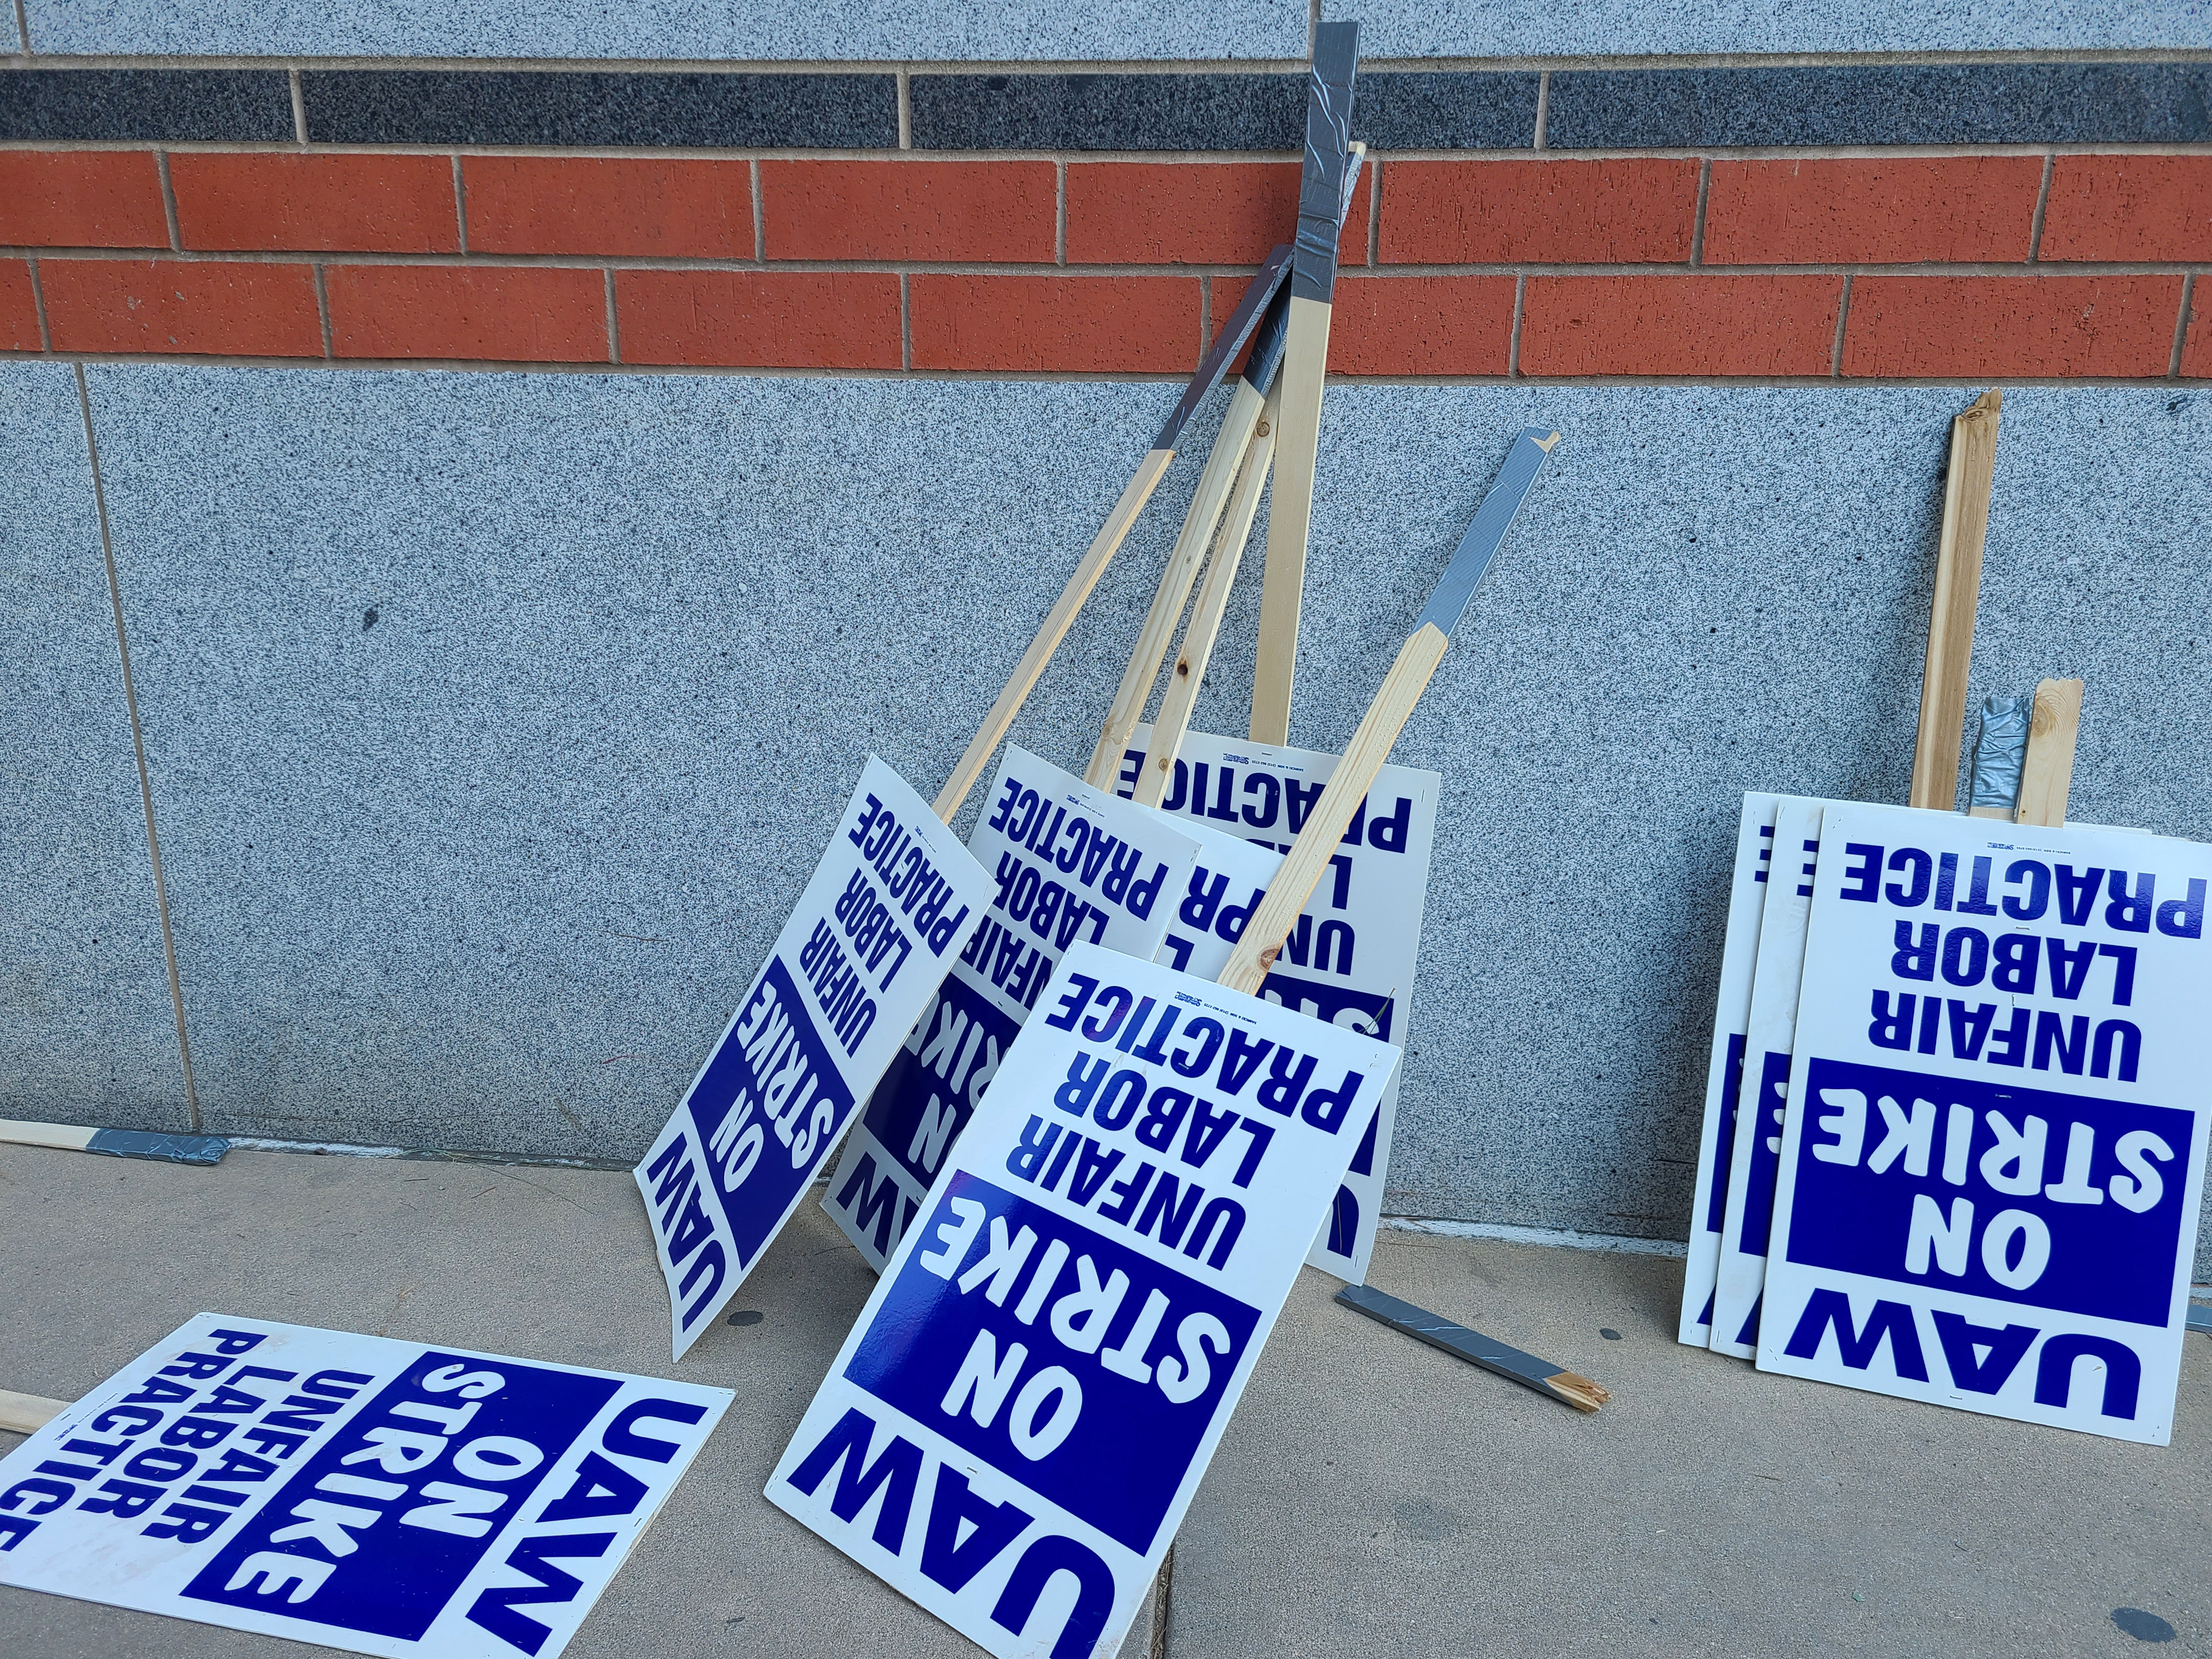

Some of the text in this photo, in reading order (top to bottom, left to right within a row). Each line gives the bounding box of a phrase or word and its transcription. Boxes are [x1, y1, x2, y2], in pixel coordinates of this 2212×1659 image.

[848, 792, 970, 958] PRACTICE
[988, 777, 1169, 922] PRACTICE
[992, 850, 1110, 953] LABOR
[1840, 842, 2207, 939] PRACTICE
[799, 917, 877, 1059] UNFAIR
[834, 867, 913, 994] LABOR
[1890, 920, 2137, 1006] LABOR
[737, 981, 834, 1169] STRIKE
[1045, 972, 1365, 1135] PRACTICE
[1868, 990, 2142, 1083] UNFAIR
[709, 1087, 764, 1193] ON
[1053, 1050, 1276, 1189] LABOR
[1812, 1088, 2175, 1214] STRIKE
[647, 1131, 726, 1333] UAW
[1005, 1114, 1246, 1271] UNFAIR
[1905, 1193, 2051, 1290] ON
[920, 1196, 1230, 1403] STRIKE
[1783, 1288, 2141, 1420] UAW
[75, 1365, 299, 1518] LABOR
[139, 1369, 376, 1543] UNFAIR
[940, 1328, 1082, 1461] ON
[224, 1363, 505, 1603] STRIKE
[399, 1436, 544, 1538] ON
[465, 1398, 709, 1657] UAW
[785, 1407, 1115, 1659] UAW
